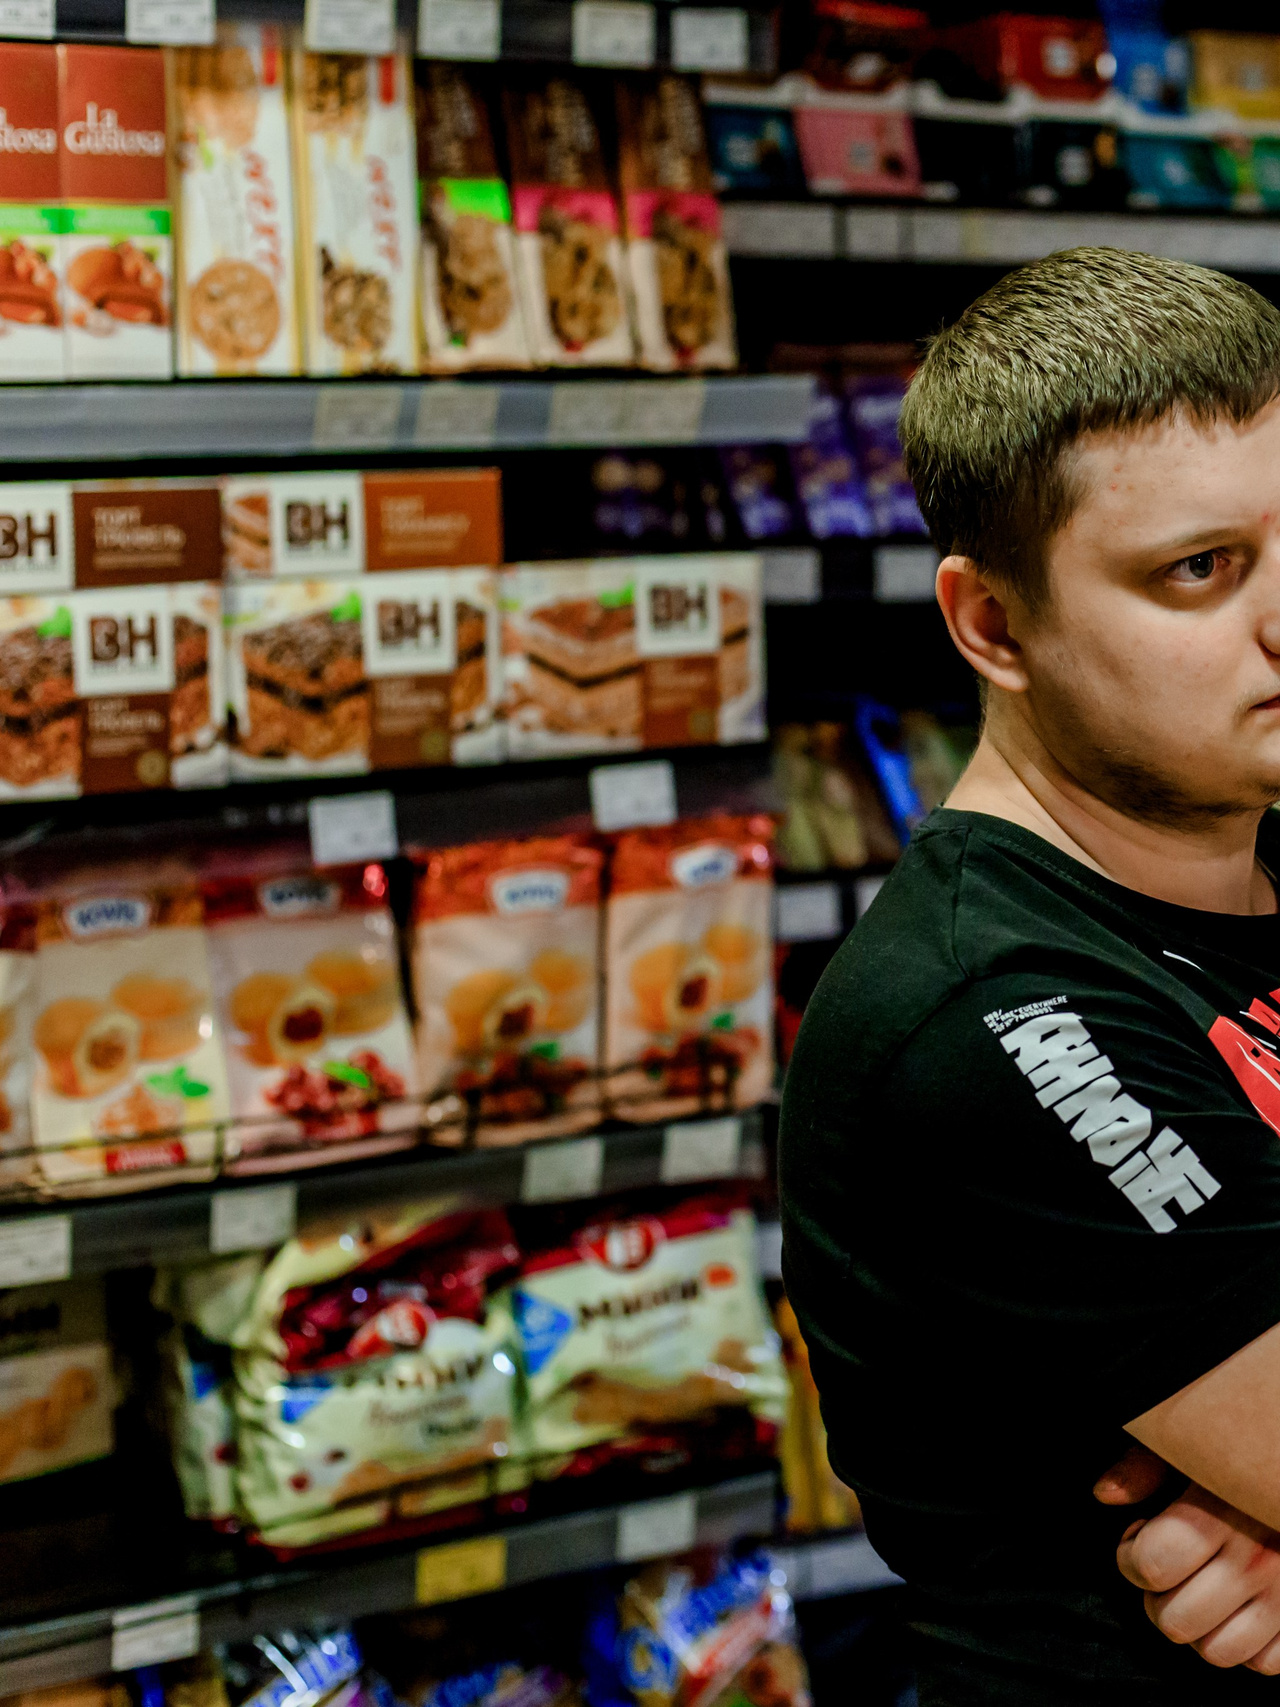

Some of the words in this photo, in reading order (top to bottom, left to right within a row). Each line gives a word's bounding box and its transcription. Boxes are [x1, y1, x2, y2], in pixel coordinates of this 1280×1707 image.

[286, 499, 348, 547] BH
[90, 615, 157, 664] BH
[378, 598, 440, 647] BH
